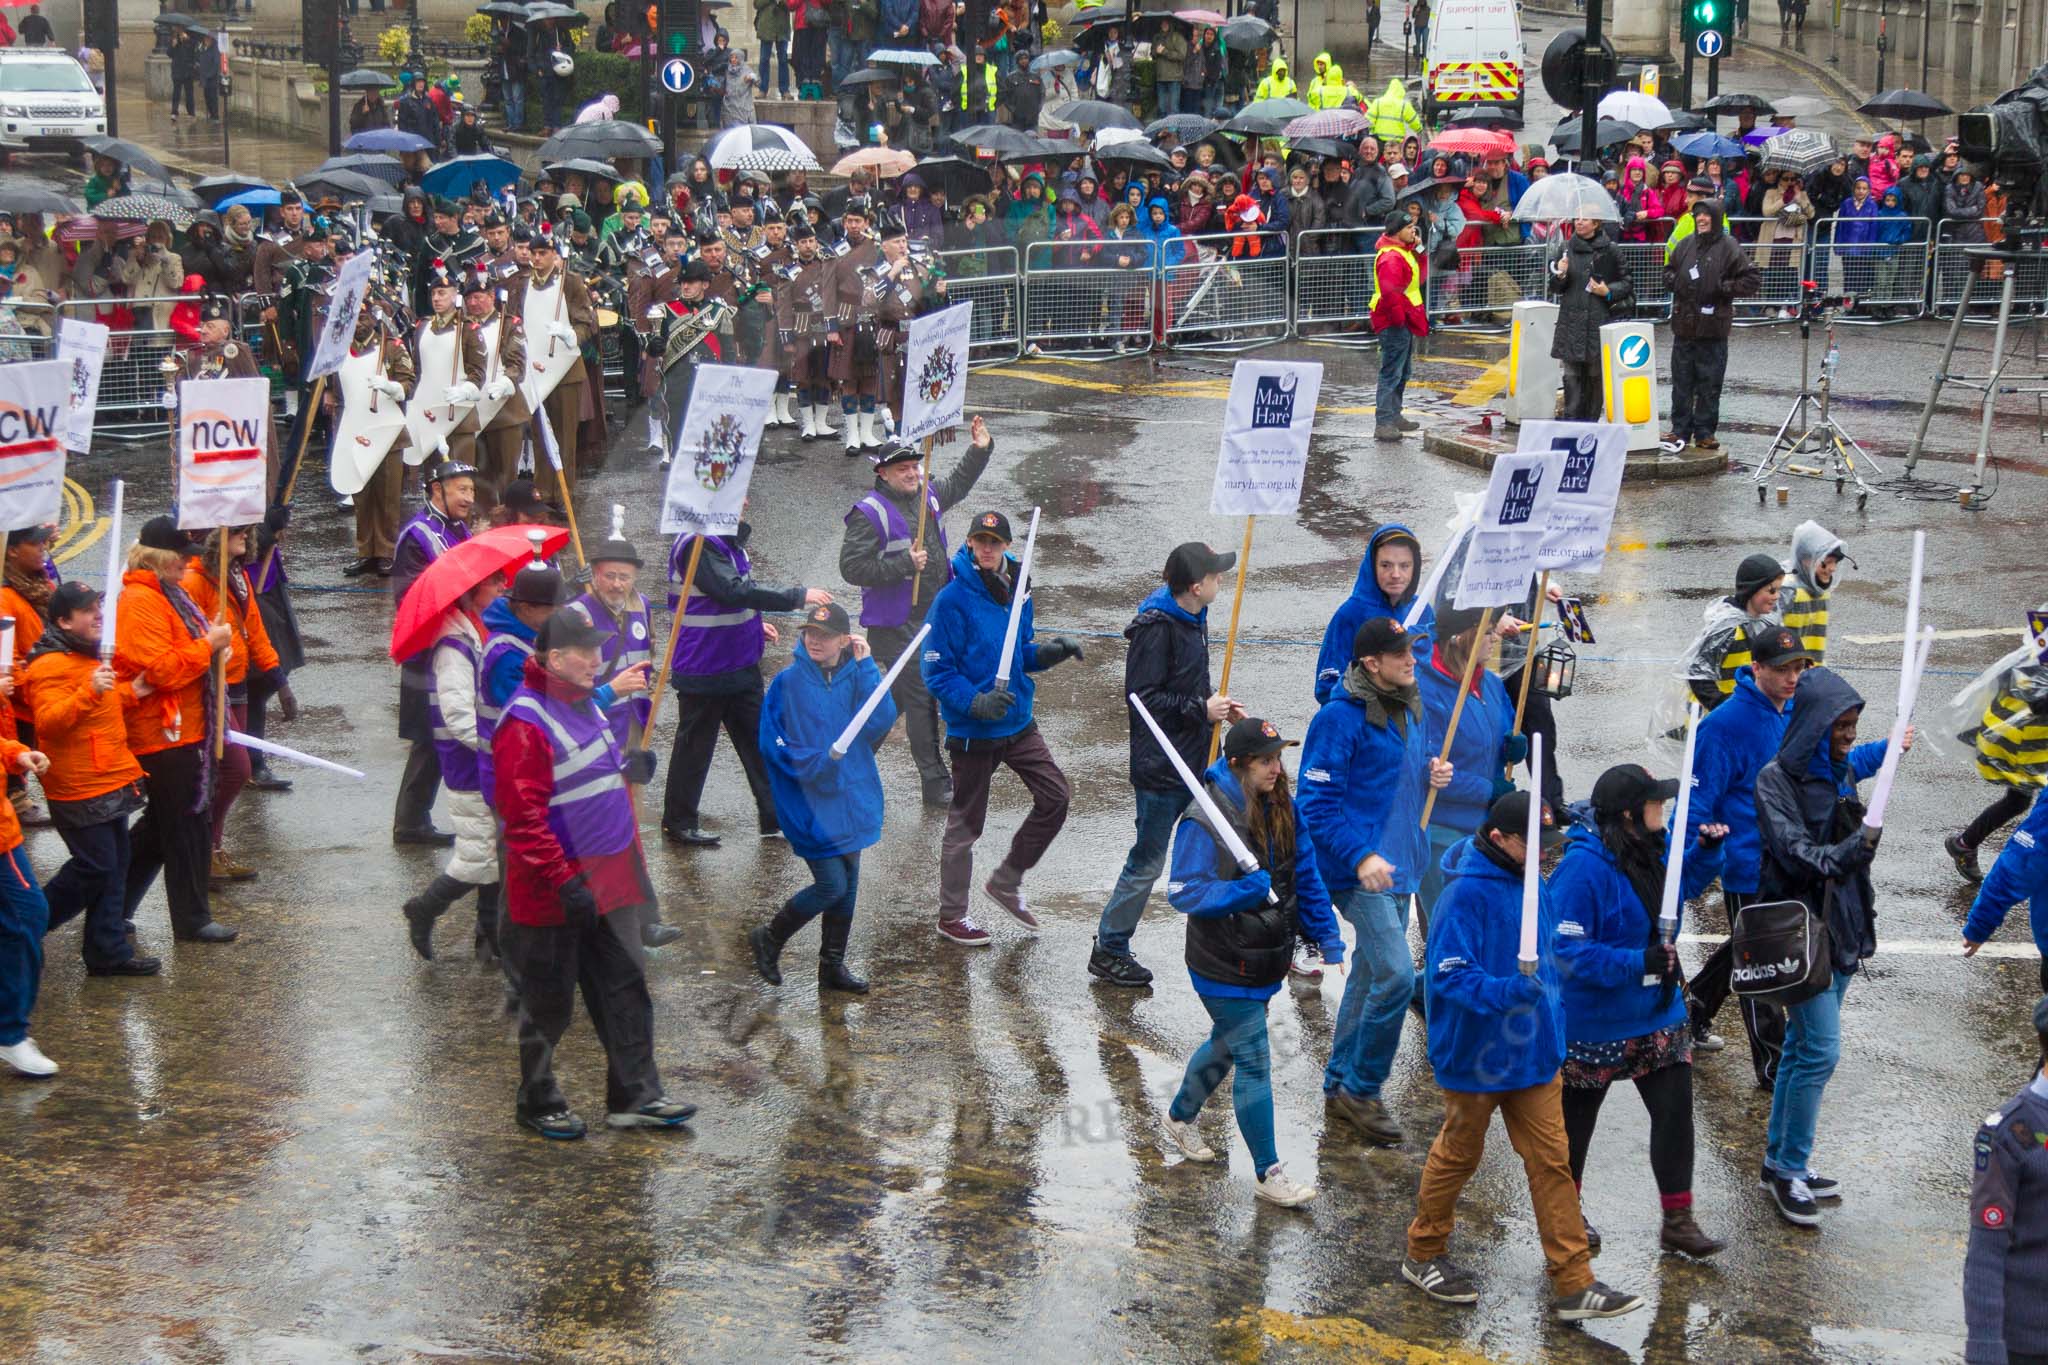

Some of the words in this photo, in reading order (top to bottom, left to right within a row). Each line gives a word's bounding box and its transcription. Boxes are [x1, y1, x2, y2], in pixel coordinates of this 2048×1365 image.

[1446, 6, 1485, 14] SUPPORT
[1256, 388, 1294, 411] Mary
[0, 405, 59, 443] cw
[1255, 406, 1291, 424] Hare
[193, 419, 259, 450] ncw
[1567, 456, 1594, 474] ary
[1562, 475, 1587, 488] are
[1506, 481, 1538, 503] Mary
[1501, 501, 1531, 521] Hare
[1733, 962, 1777, 982] adidas
